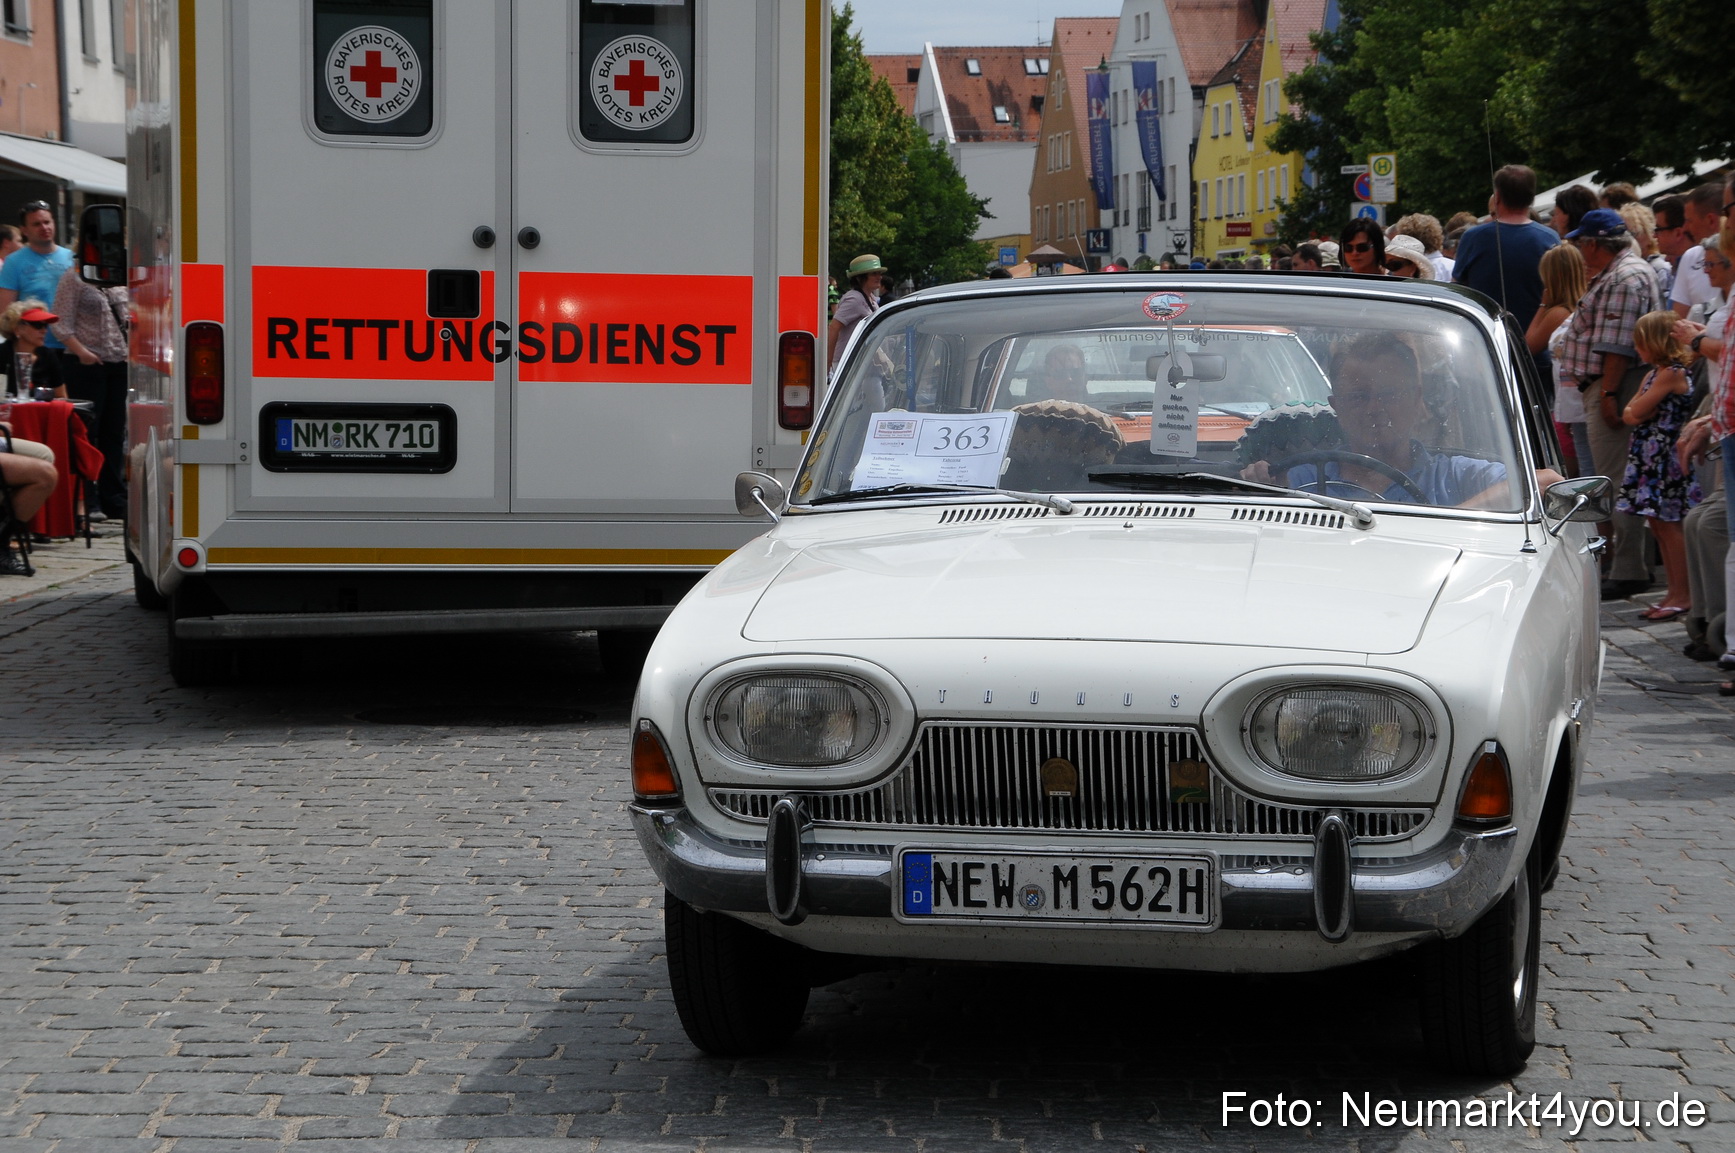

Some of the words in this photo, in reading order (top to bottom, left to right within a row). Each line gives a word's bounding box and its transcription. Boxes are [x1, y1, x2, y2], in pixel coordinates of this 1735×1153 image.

[334, 33, 414, 71] BAYERISCHES
[598, 42, 676, 79] BAYERISCHES
[333, 75, 370, 115] ROTES
[376, 77, 414, 115] KREUZ
[597, 84, 634, 123] ROTES
[639, 86, 676, 123] KREUZ
[1146, 114, 1160, 165] RUPPERT
[267, 317, 737, 366] RETTUNGSDIENST
[1162, 404, 1190, 412] gucken,
[1170, 394, 1184, 402] Nur
[281, 438, 288, 446] D
[294, 422, 329, 448] NM
[345, 423, 380, 448] RK
[385, 423, 434, 449] 710
[933, 425, 991, 451] 363
[1158, 422, 1193, 431] anfassen!
[938, 689, 1180, 708] TAUNUS
[912, 890, 923, 903] D
[933, 861, 1015, 908] NEW
[1053, 864, 1079, 910] M
[1091, 864, 1204, 915] 562H
